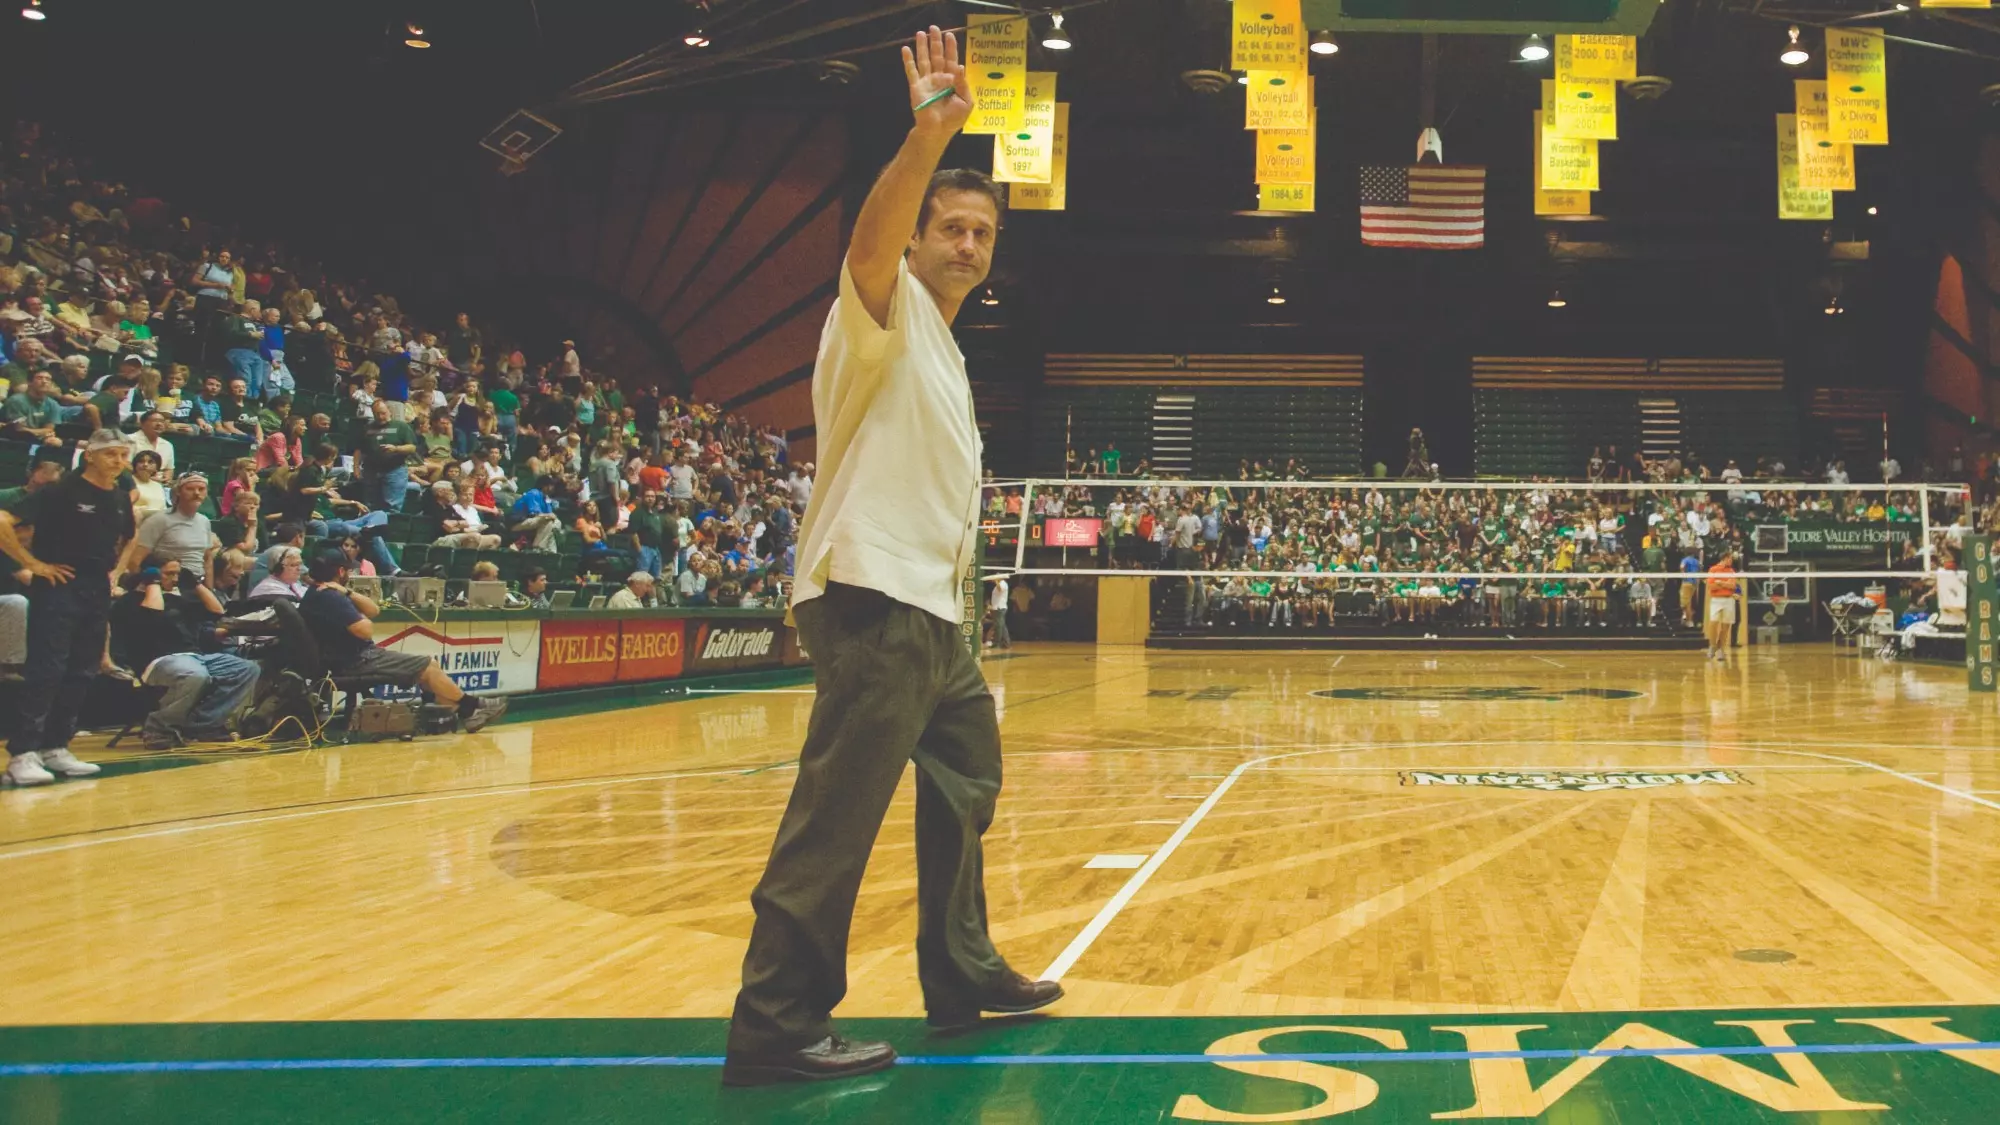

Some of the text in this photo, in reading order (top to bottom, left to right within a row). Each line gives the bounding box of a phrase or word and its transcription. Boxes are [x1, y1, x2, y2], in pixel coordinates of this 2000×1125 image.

[982, 23, 1012, 35] MWC
[1240, 23, 1294, 38] Volleyball
[969, 37, 1025, 50] Tournament
[1840, 37, 1870, 49] MWC
[971, 52, 1022, 66] Champions
[1828, 49, 1881, 61] Conference
[1830, 62, 1881, 74] Champions
[976, 86, 1016, 97] Women's
[1025, 86, 1038, 96] AC
[978, 99, 1012, 111] Softball
[1256, 92, 1299, 106] Volleyball
[1835, 96, 1881, 110] Swimming
[983, 116, 1006, 126] 2003
[1849, 111, 1878, 124] Diving
[1005, 145, 1040, 156] Softball
[1013, 161, 1032, 171] 1997
[1549, 157, 1591, 168] Basketball
[1787, 530, 1822, 543] OUDRE
[1823, 528, 1861, 542] VALLEY
[545, 632, 679, 665] WELLS FARGO
[702, 627, 774, 659] Gatorade
[1979, 600, 1992, 686] RAMS
[454, 650, 500, 670] FAMILY
